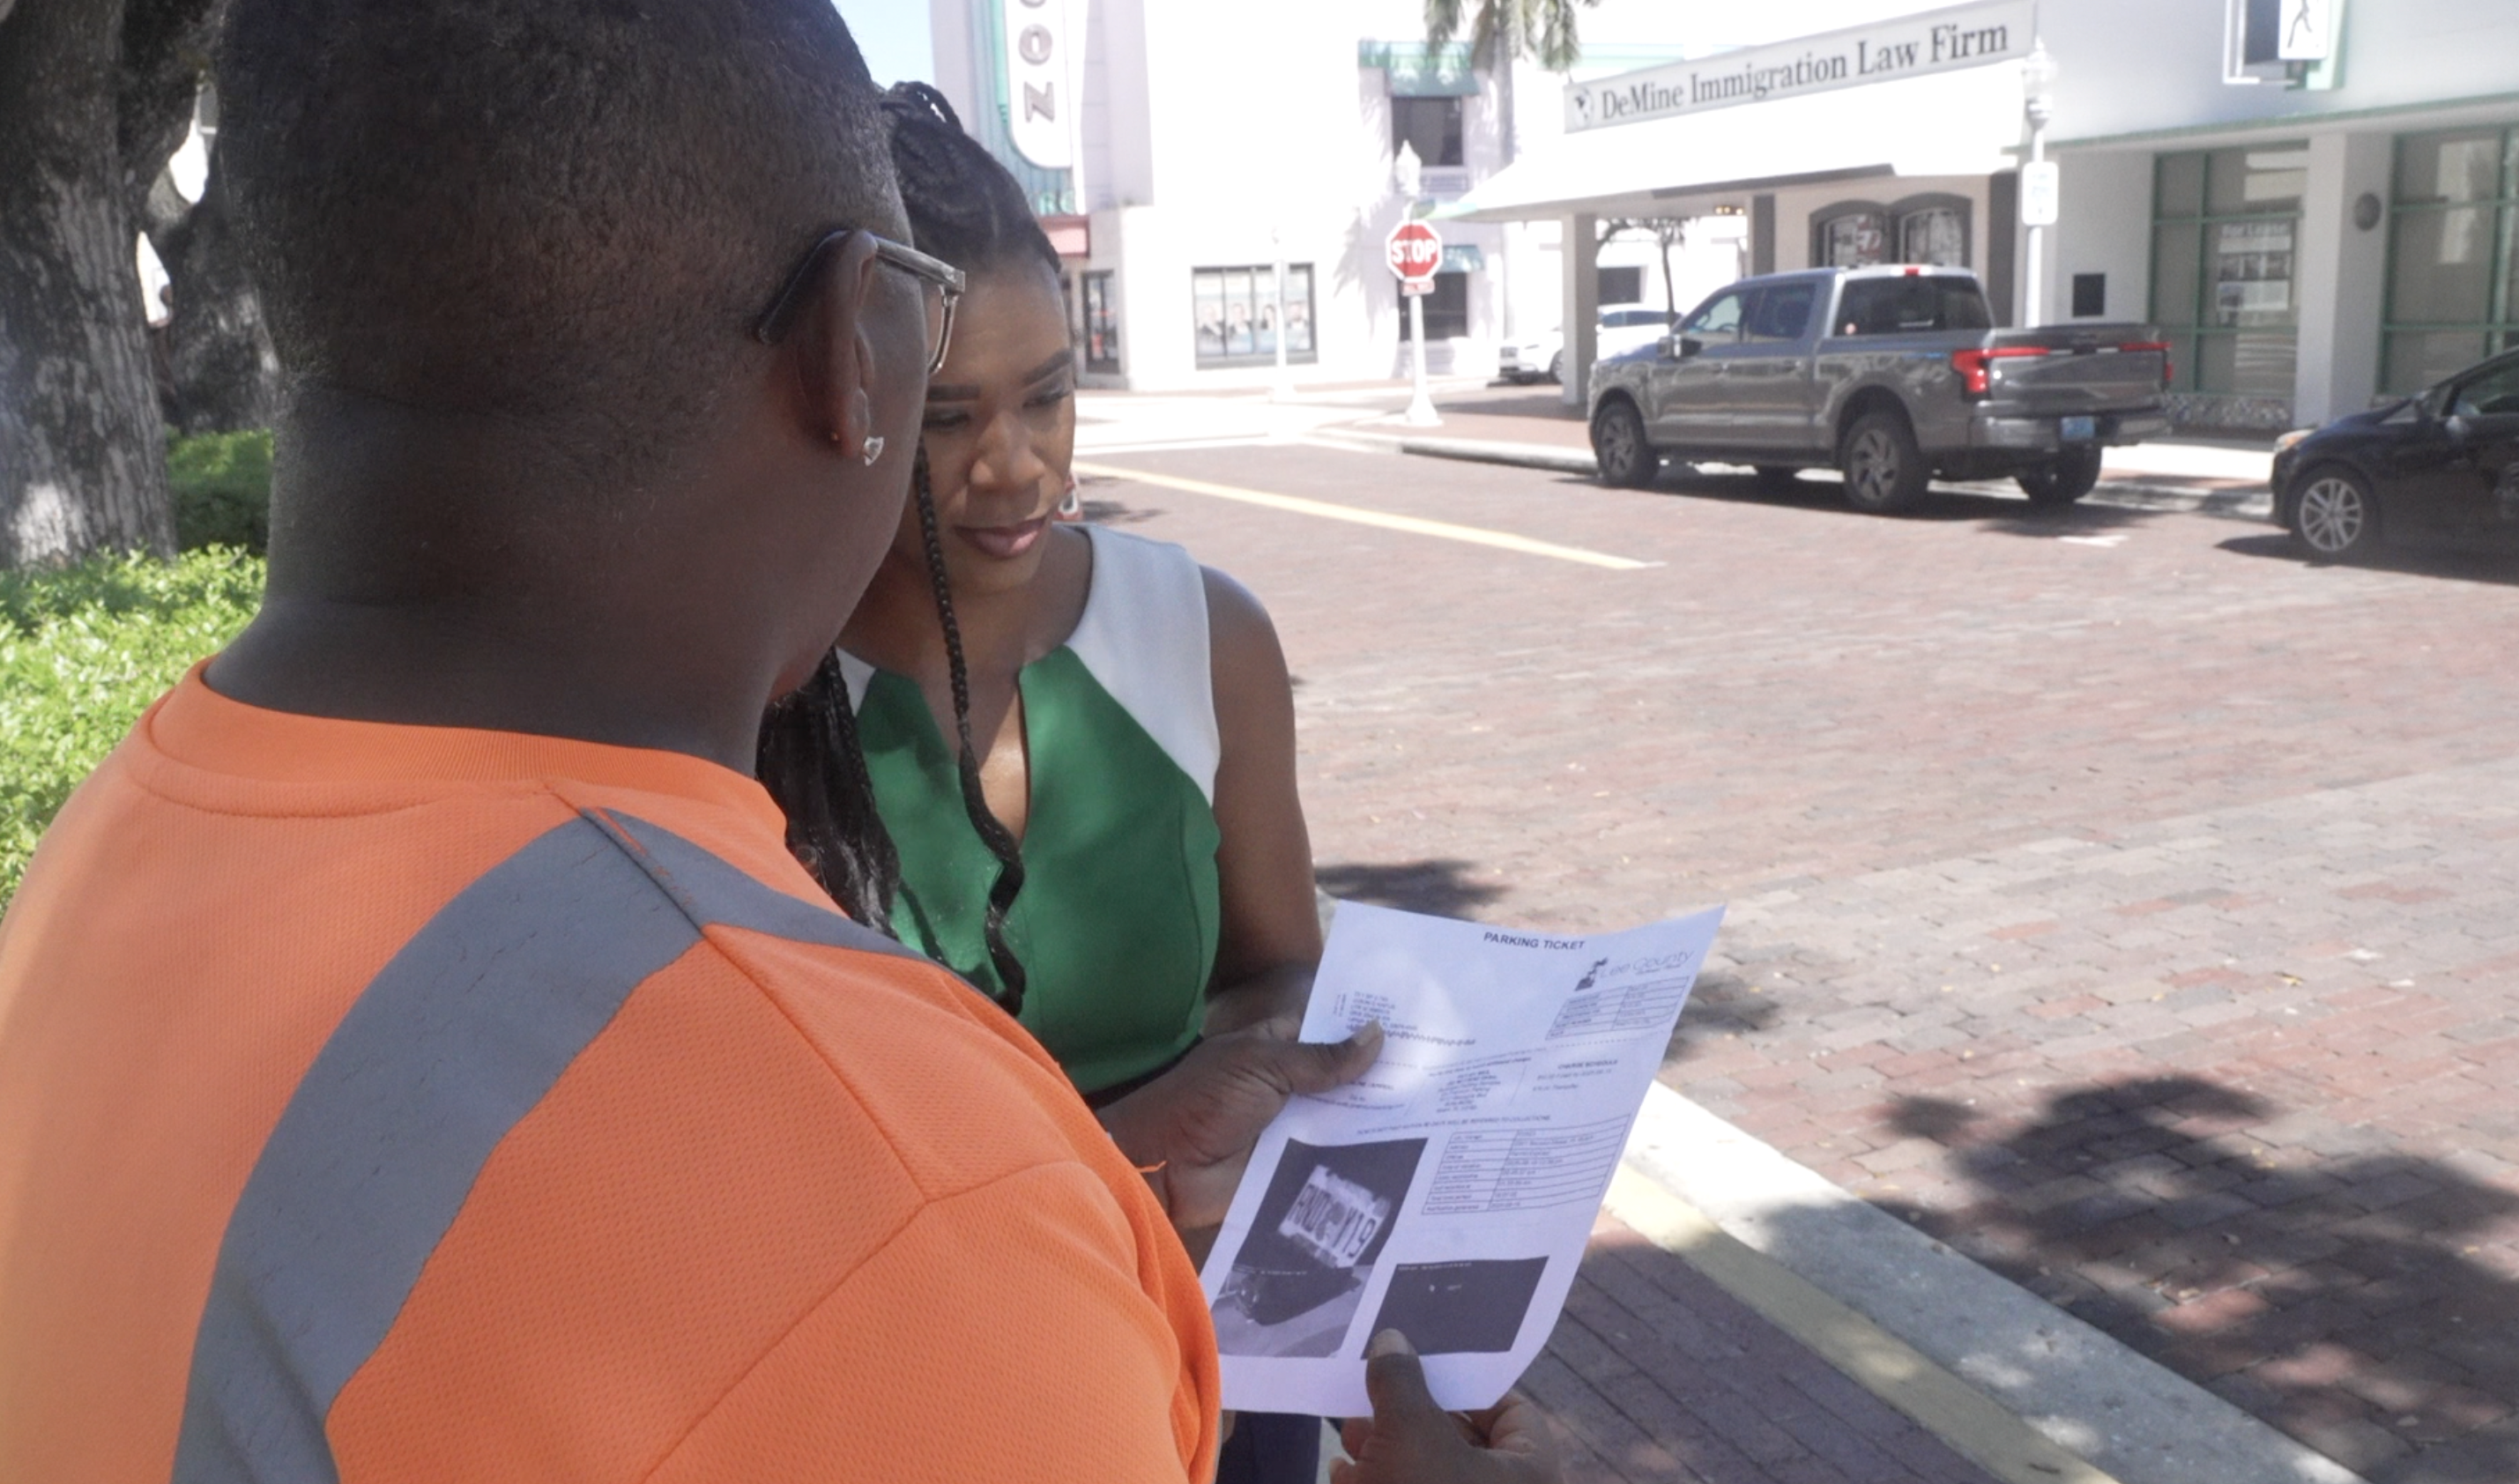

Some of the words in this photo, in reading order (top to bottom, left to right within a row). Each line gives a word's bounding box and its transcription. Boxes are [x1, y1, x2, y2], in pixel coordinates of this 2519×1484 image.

[1602, 83, 1683, 120] DeMine
[1690, 54, 1847, 99] Immigration
[1857, 40, 1921, 77] Law
[1929, 22, 2010, 63] Firm
[1391, 239, 1438, 263] STOP
[1483, 931, 1539, 949] PARKING
[1543, 939, 1586, 950] TICKET
